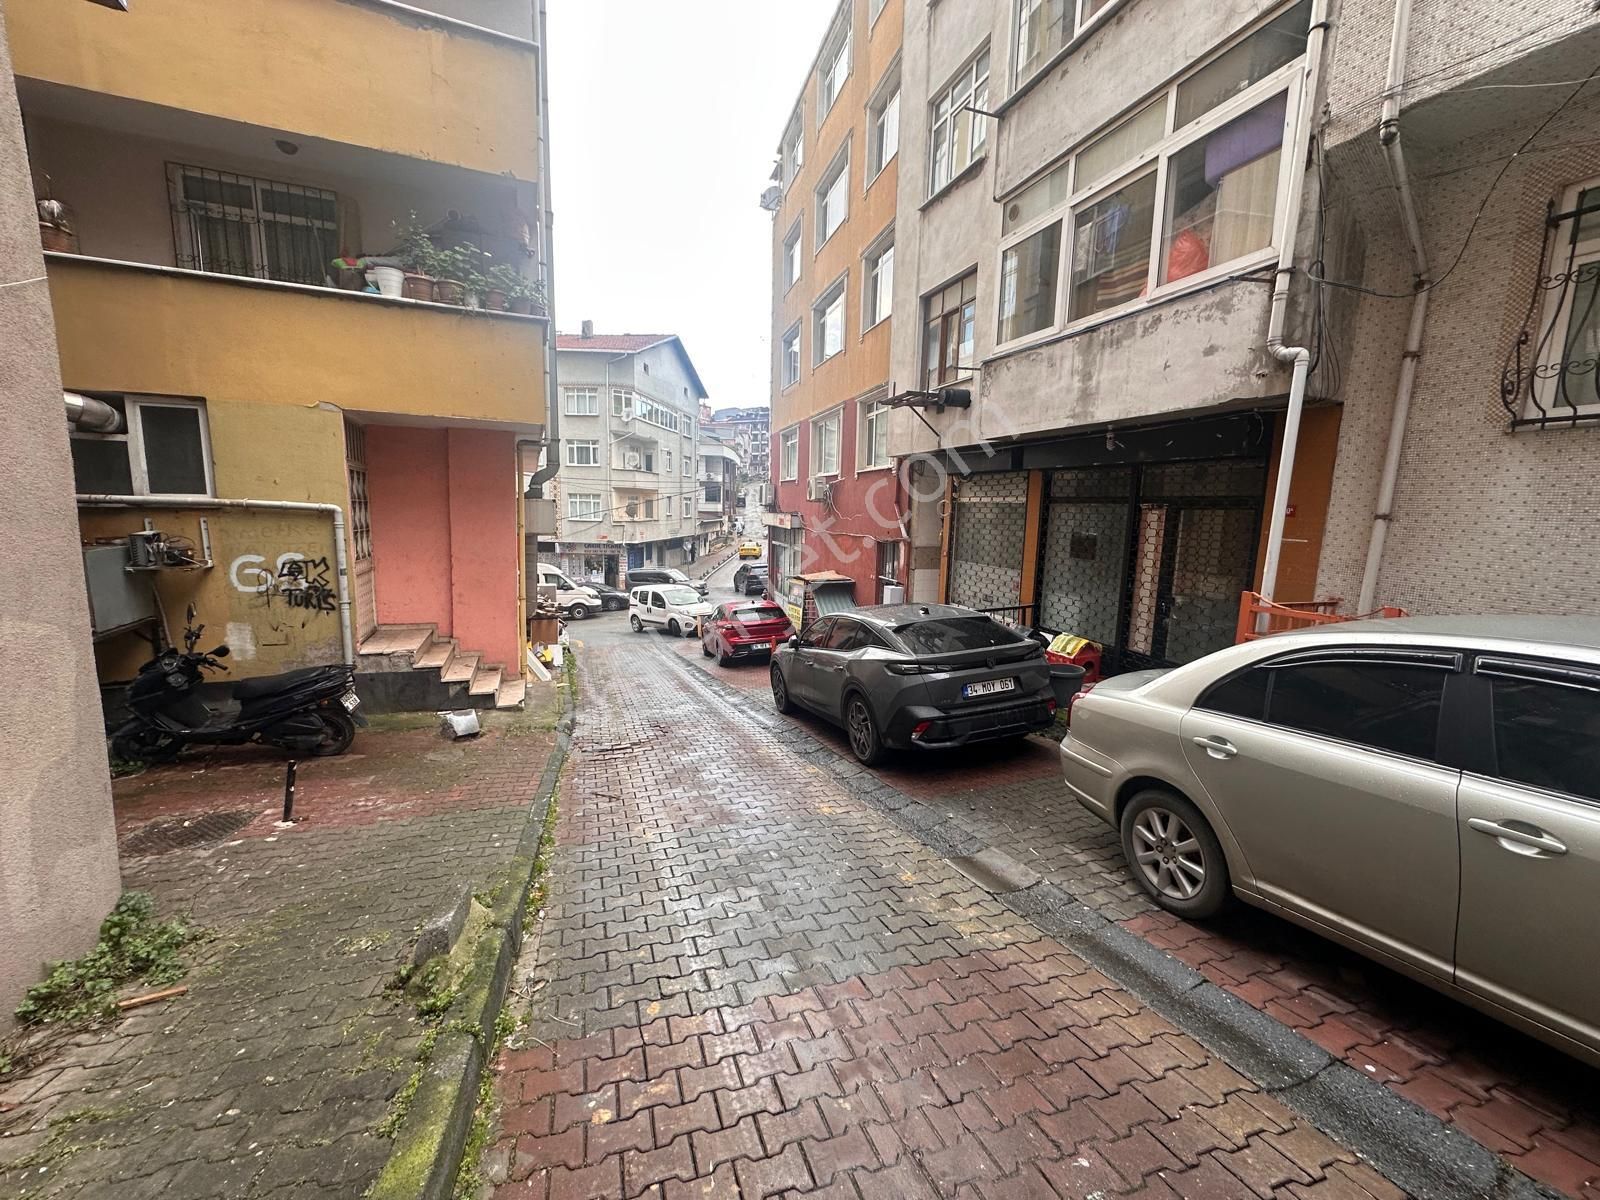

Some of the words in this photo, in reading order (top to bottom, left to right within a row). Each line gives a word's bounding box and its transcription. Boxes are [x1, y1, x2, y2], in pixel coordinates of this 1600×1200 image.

[968, 685, 978, 695] 34
[981, 681, 995, 693] MOY
[1000, 678, 1013, 690] 061
